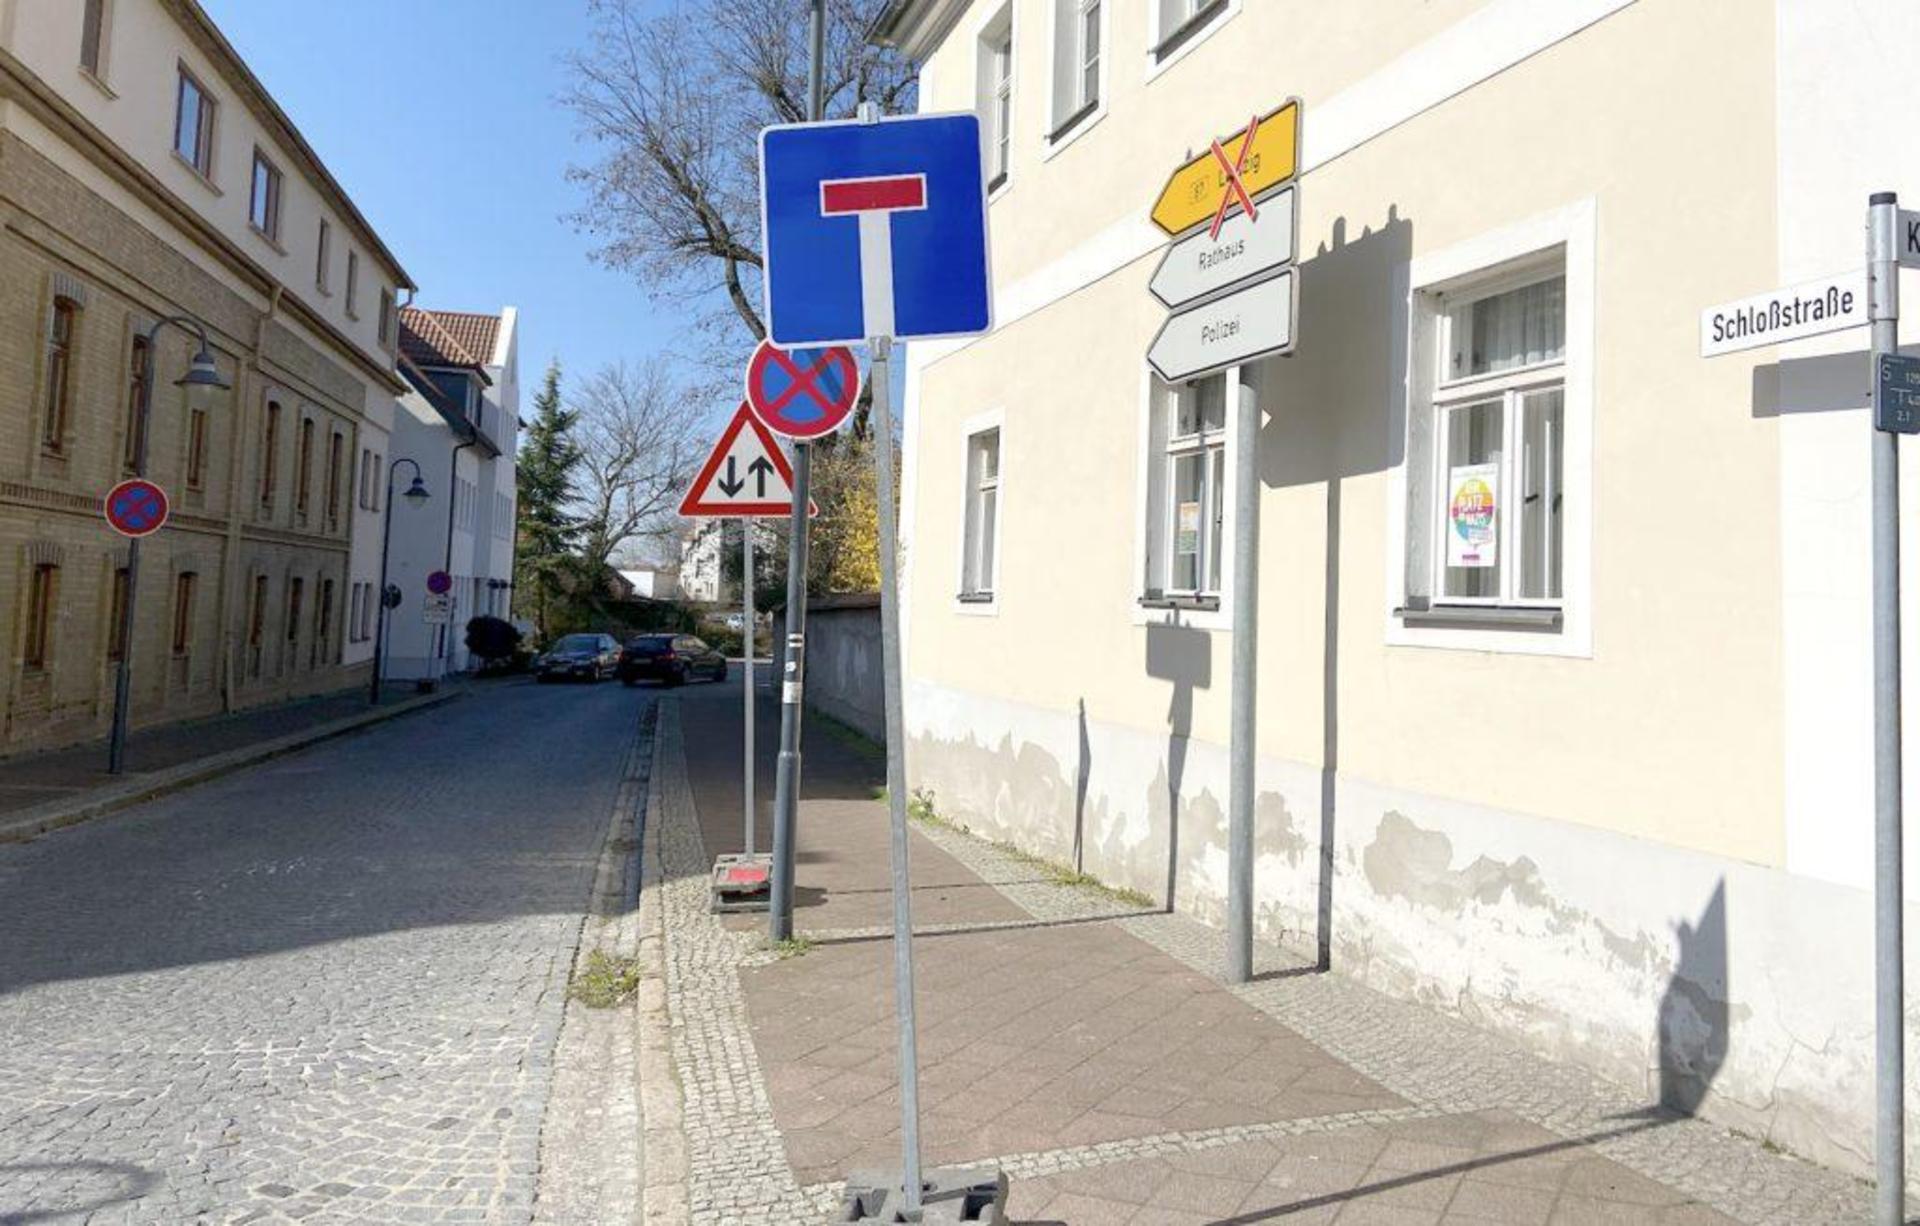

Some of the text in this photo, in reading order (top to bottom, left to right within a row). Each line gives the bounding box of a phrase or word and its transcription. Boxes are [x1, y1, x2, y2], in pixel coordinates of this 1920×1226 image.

[1199, 239, 1245, 272] Rathaus
[1712, 285, 1854, 343] Schloßstraße
[1201, 319, 1241, 346] Polizei
